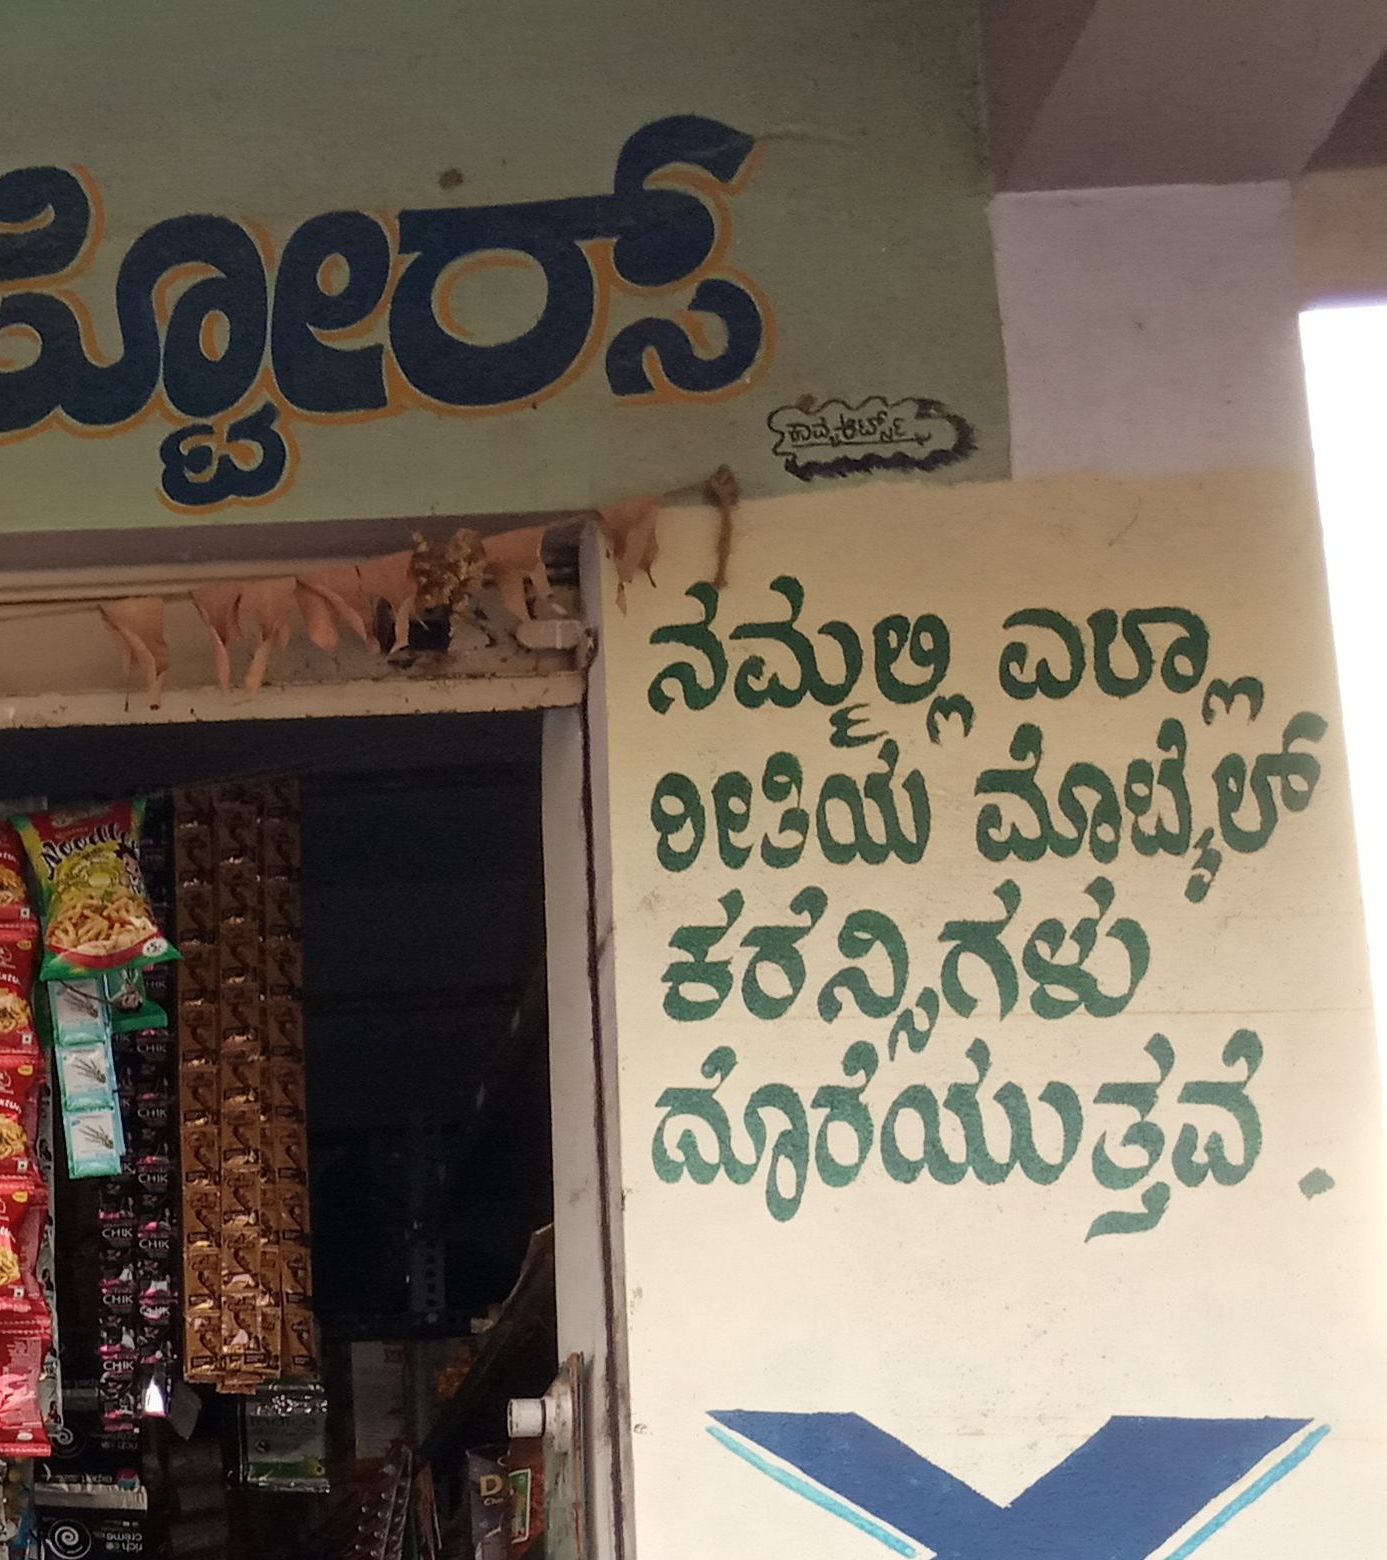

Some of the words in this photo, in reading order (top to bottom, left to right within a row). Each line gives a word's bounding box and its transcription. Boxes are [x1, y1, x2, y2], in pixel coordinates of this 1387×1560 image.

[648, 575, 976, 748] ನಮ್ಮಲ್ಲಿ
[999, 607, 1264, 726] ಎಲ್ಲಾ
[651, 739, 931, 872] ರೀತಿಯ
[974, 711, 1328, 903] ಮೊಬೈಲ್
[662, 877, 1150, 1062] ಕರೆನ್ಸಿಗಳು
[137, 1043, 167, 1053] CHIK
[137, 1108, 167, 1118] CHIK
[138, 1174, 168, 1184] CHIK
[102, 1227, 133, 1238] CHIK
[139, 1238, 169, 1249] CHIK
[102, 1294, 133, 1305] CHIK
[103, 1361, 134, 1372] CHIK
